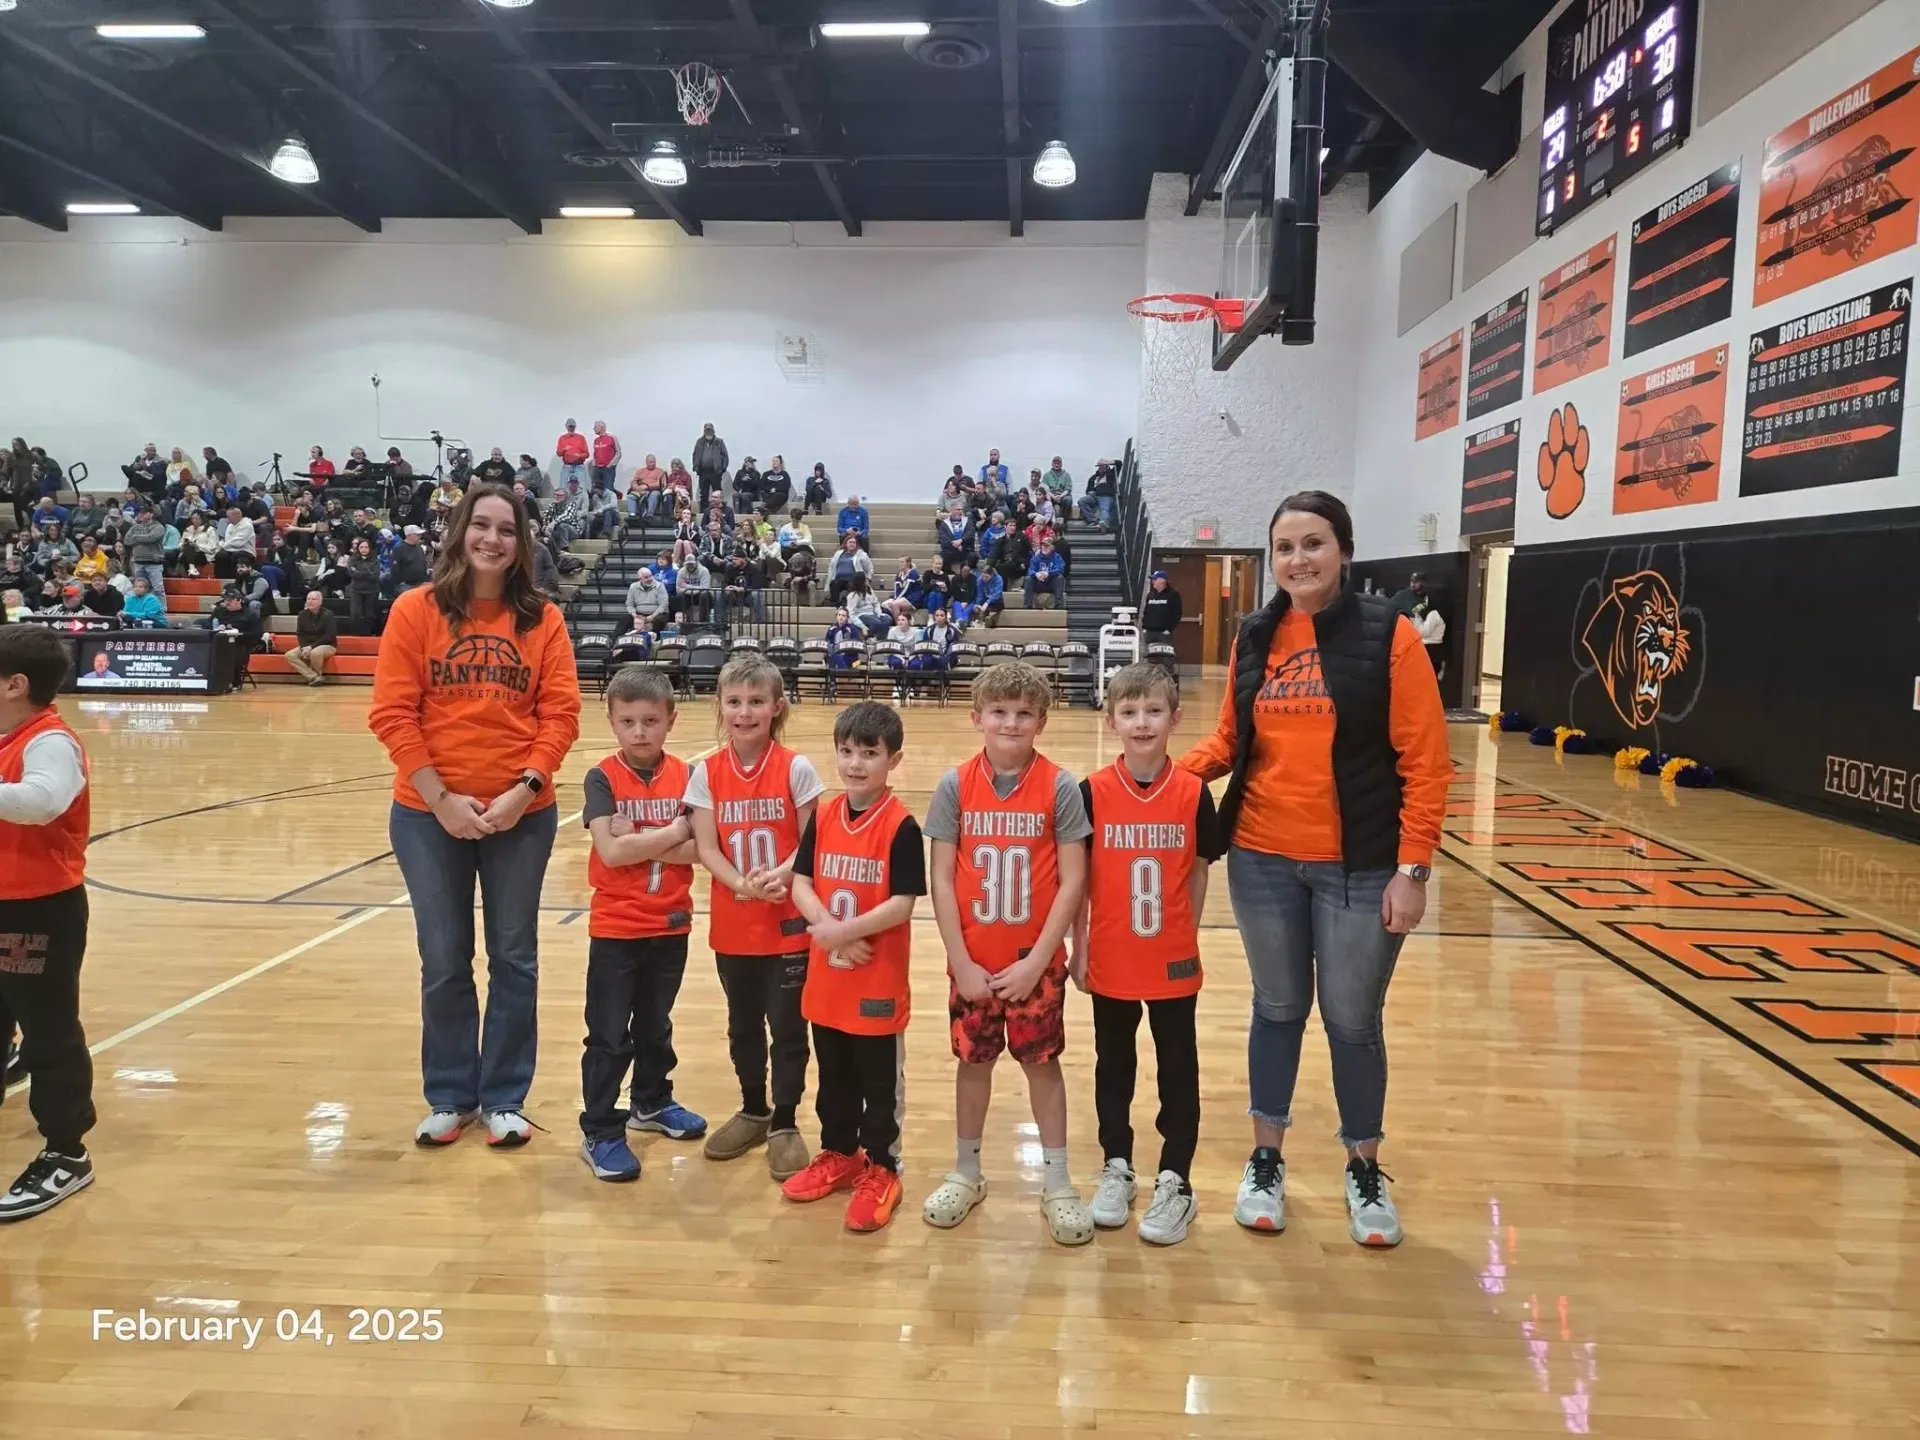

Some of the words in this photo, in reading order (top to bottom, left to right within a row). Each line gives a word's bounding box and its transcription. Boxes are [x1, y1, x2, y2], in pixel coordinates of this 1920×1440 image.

[1809, 84, 1870, 136] VOLLEYBALL
[1658, 197, 1677, 223] BOYS
[1678, 180, 1708, 210] SOCCER
[1832, 194, 1841, 209] 21
[1824, 215, 1868, 241] CHAMPIONS
[1779, 322, 1806, 344] BOYS
[1807, 296, 1871, 336] WRESTLING
[1769, 375, 1776, 387] 10
[1779, 372, 1786, 384] 11
[1789, 369, 1796, 382] 12
[1799, 366, 1806, 379] 14
[1810, 363, 1817, 376] 15
[1821, 360, 1828, 373] 16
[1832, 357, 1840, 370] 18
[1844, 354, 1852, 368] 20
[1855, 350, 1864, 364] 21
[1867, 346, 1876, 361] 22
[1880, 343, 1889, 357] 23
[1892, 339, 1901, 354] 24
[1780, 358, 1787, 371] 91
[1800, 352, 1808, 365] 93
[1811, 349, 1818, 362] 95
[1822, 346, 1829, 359] 96
[1833, 343, 1840, 356] 00
[1844, 339, 1853, 353] 03
[1856, 336, 1865, 349] 04
[1868, 332, 1877, 346] 05
[1881, 328, 1890, 342] 06
[1894, 324, 1904, 338] 07
[1666, 360, 1695, 385] SOCCER
[1756, 420, 1763, 432] 91
[1775, 416, 1782, 428] 94
[1785, 413, 1792, 426] 95
[1795, 411, 1803, 423] 99
[1806, 408, 1814, 421] 00
[1818, 406, 1826, 418] 06
[1829, 403, 1837, 416] 10
[1841, 401, 1849, 414] 14
[1852, 397, 1860, 411] 15
[1864, 395, 1873, 408] 16
[1877, 392, 1886, 405] 17
[1890, 389, 1899, 402] 18
[1745, 436, 1752, 448] 20
[1755, 434, 1762, 446] 21
[1764, 431, 1771, 443] 23
[106, 641, 185, 651] PANTHERS
[429, 658, 531, 693] PANTHERS
[1255, 705, 1334, 714] BASKETBA
[1825, 756, 1906, 809] HOME
[617, 798, 681, 821] PANTHER
[718, 797, 785, 823] PANTHERS
[964, 812, 1045, 836] PANTHERS
[1104, 824, 1185, 849] PANTHERS
[728, 827, 778, 900] 10
[972, 844, 1031, 924] 30
[1131, 856, 1163, 937] 8
